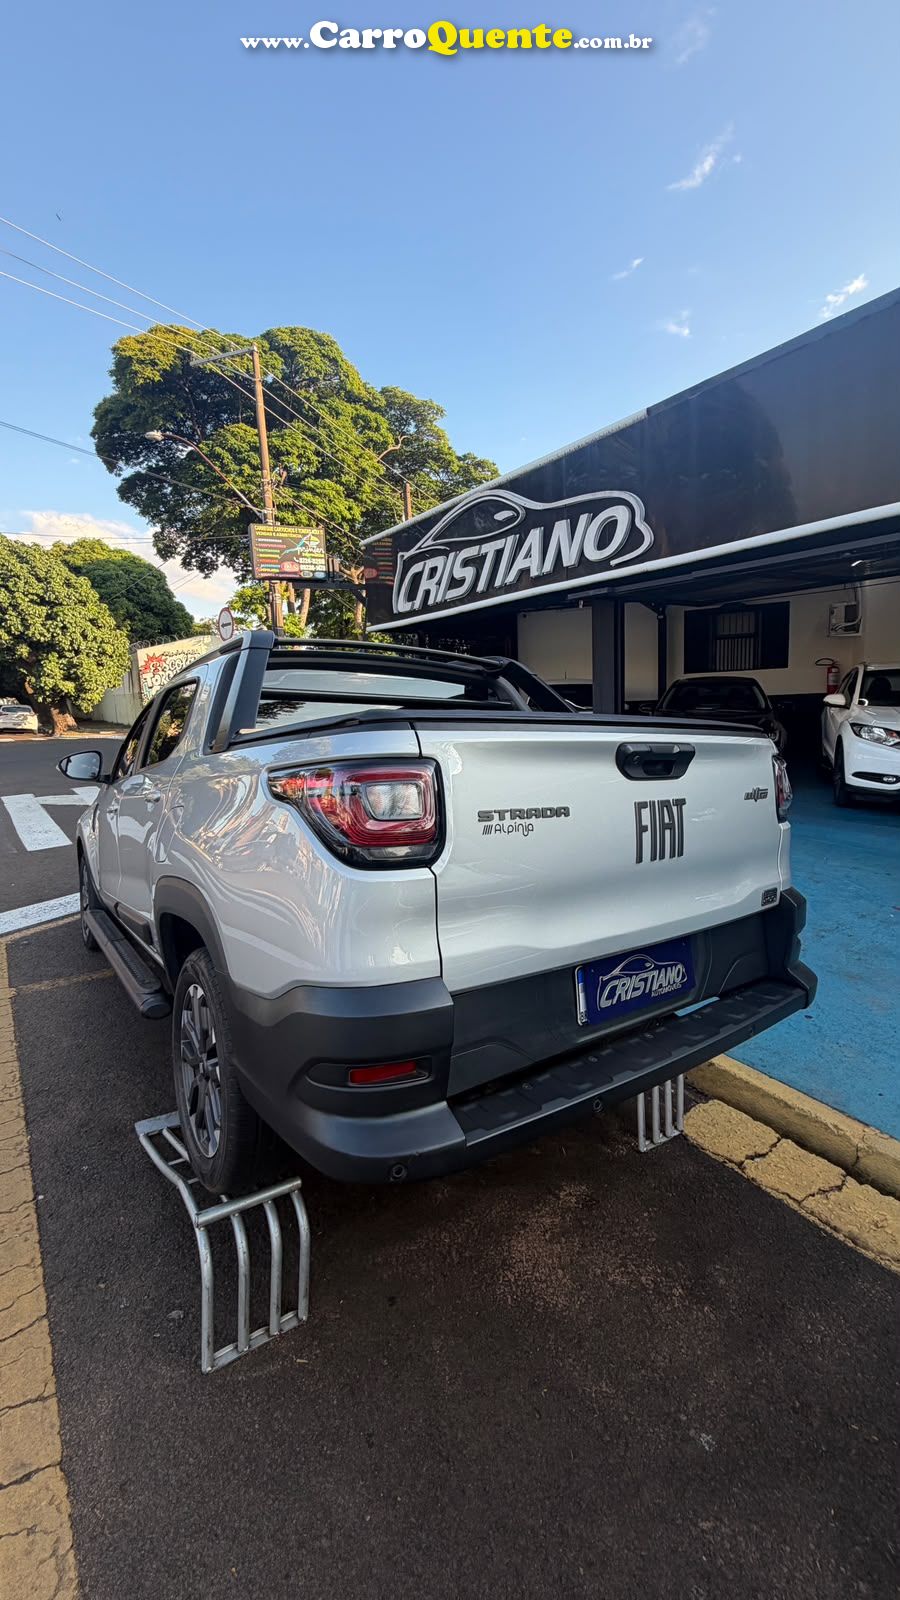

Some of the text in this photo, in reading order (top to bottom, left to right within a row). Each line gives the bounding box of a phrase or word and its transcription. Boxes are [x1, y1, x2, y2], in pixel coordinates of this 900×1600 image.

[398, 505, 632, 613] CRISTIANO
[478, 806, 570, 822] STRADA
[634, 798, 686, 864] FIAT
[599, 964, 683, 1008] CRISTIANO
